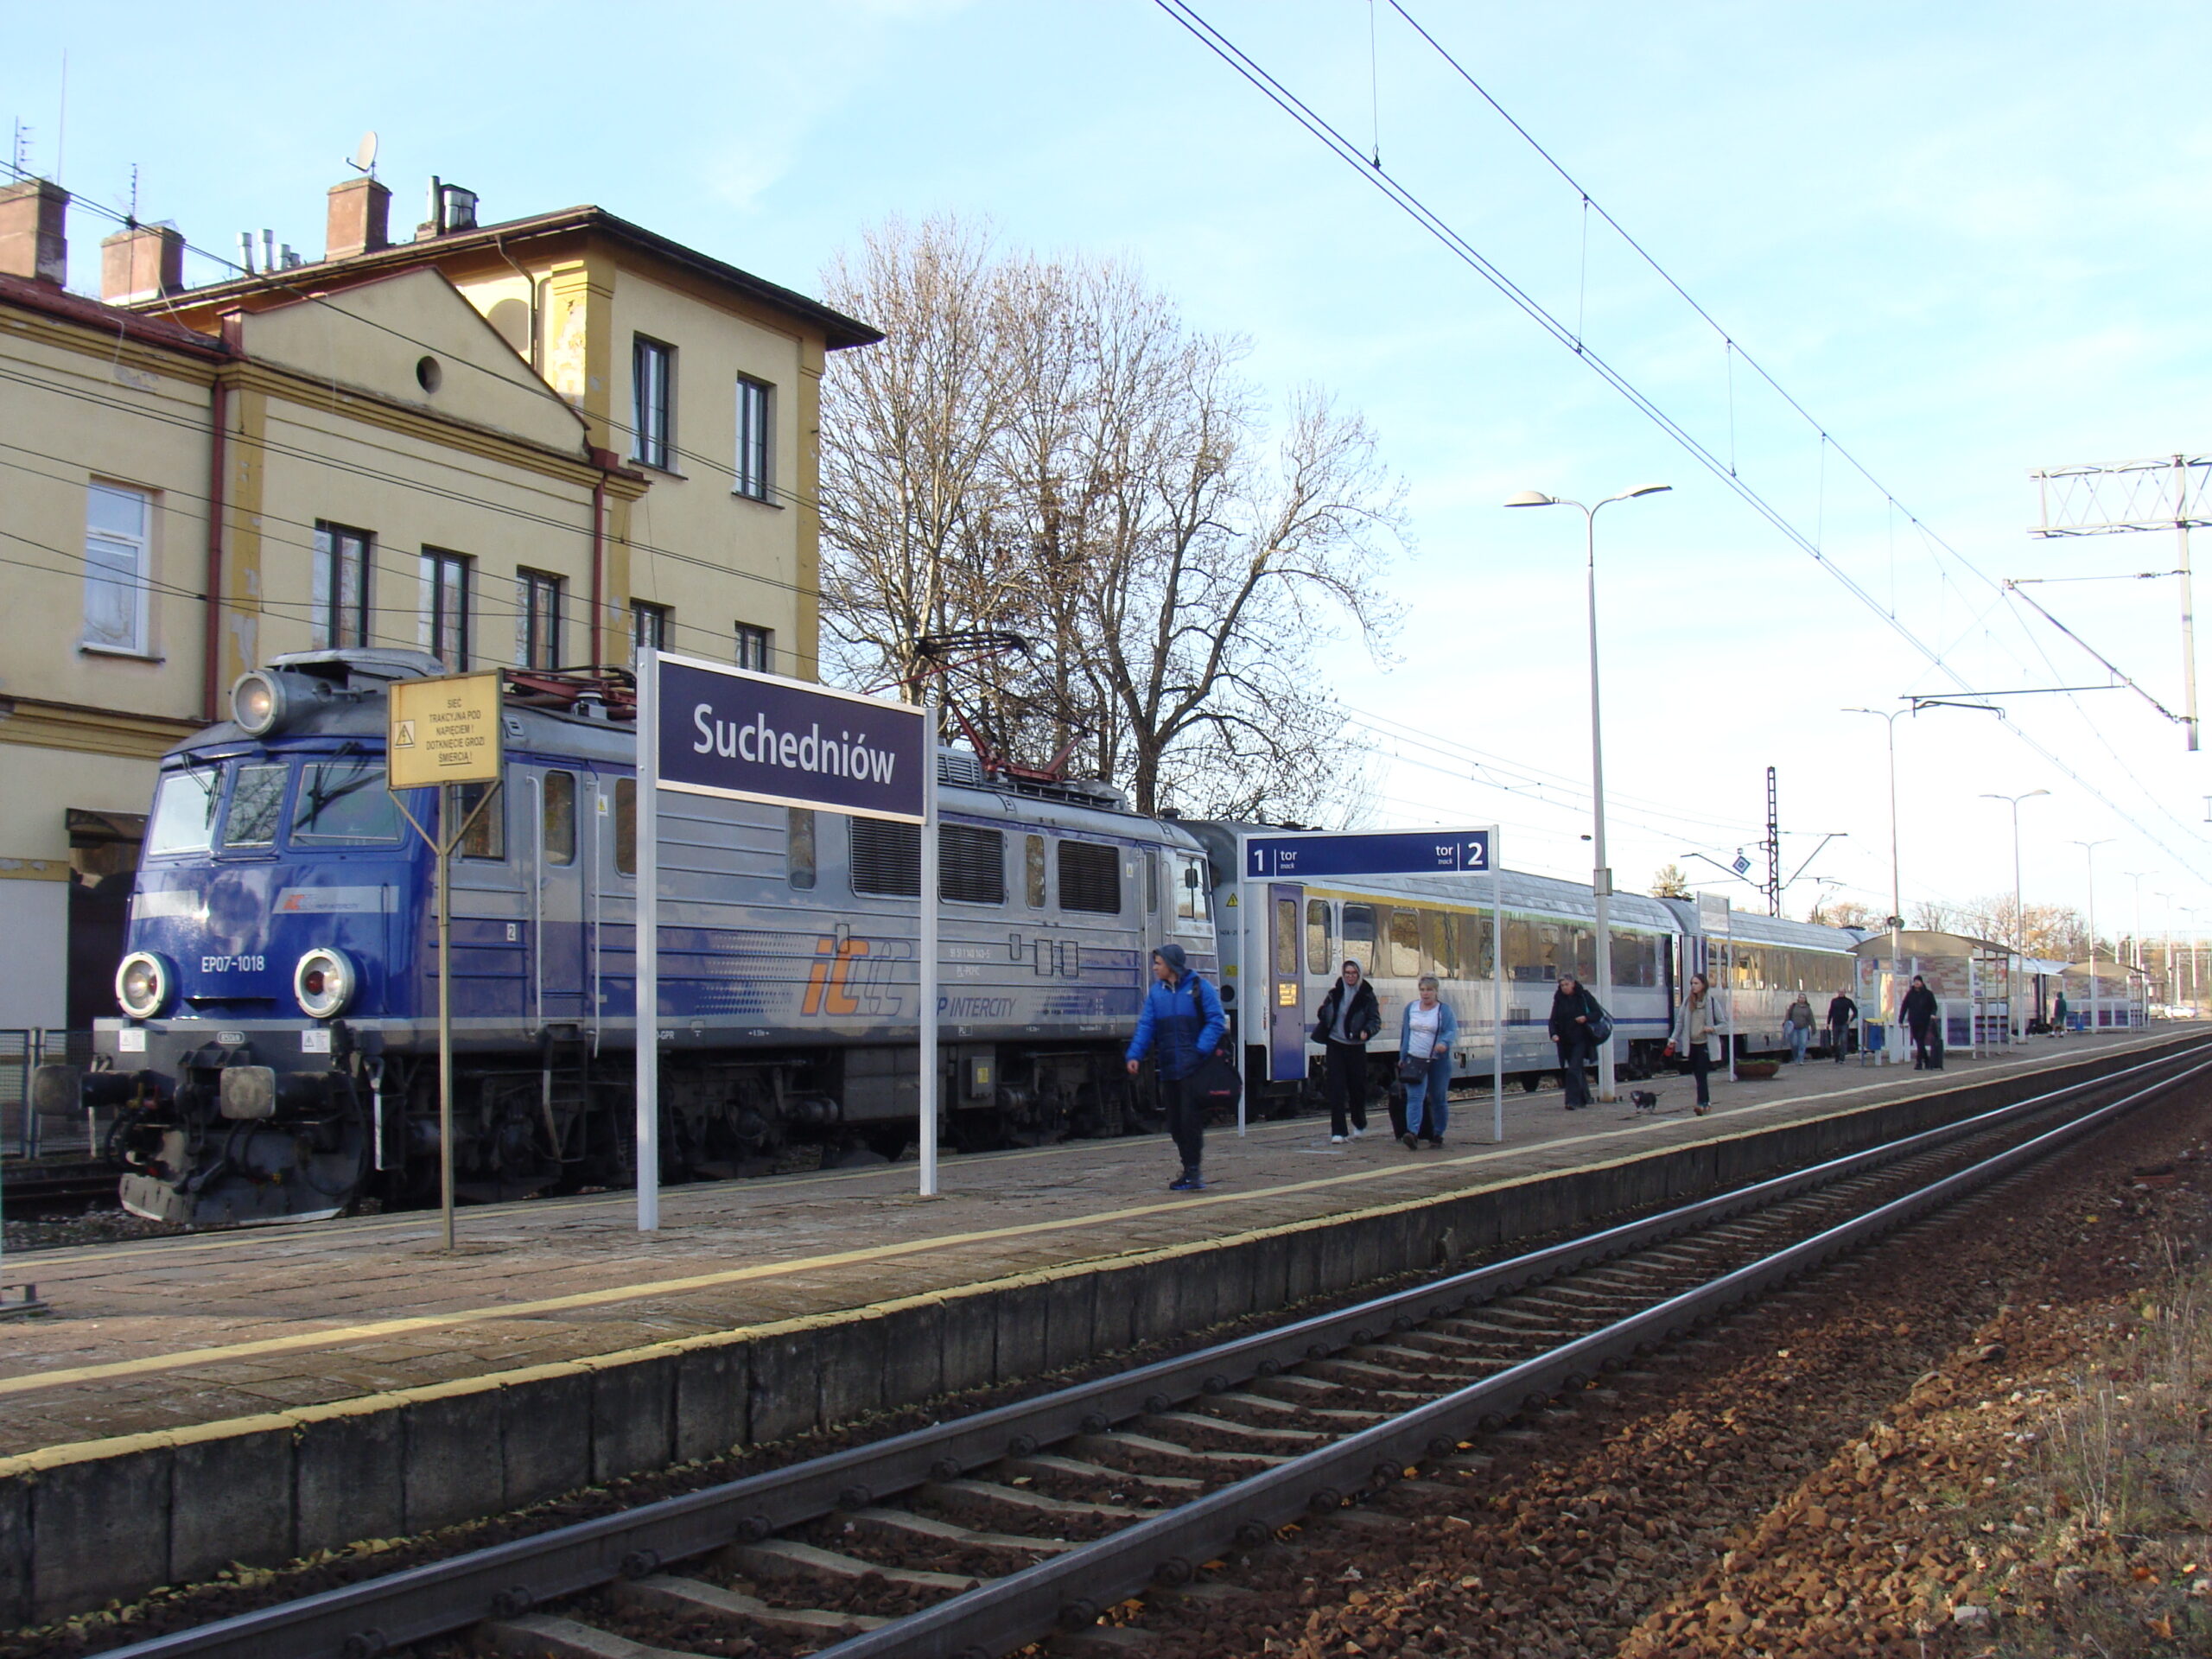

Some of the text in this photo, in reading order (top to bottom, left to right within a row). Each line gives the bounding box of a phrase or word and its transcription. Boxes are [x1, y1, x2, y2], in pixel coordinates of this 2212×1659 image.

[429, 709, 481, 723] TRAKCYJNA POD
[465, 736, 485, 747] GROZI
[692, 702, 896, 785] Suchedniów
[1254, 849, 1298, 872] 1 tor
[1435, 842, 1484, 866] tor 2
[201, 956, 265, 973] EP07-1018
[950, 997, 1017, 1017] INTERCITY
